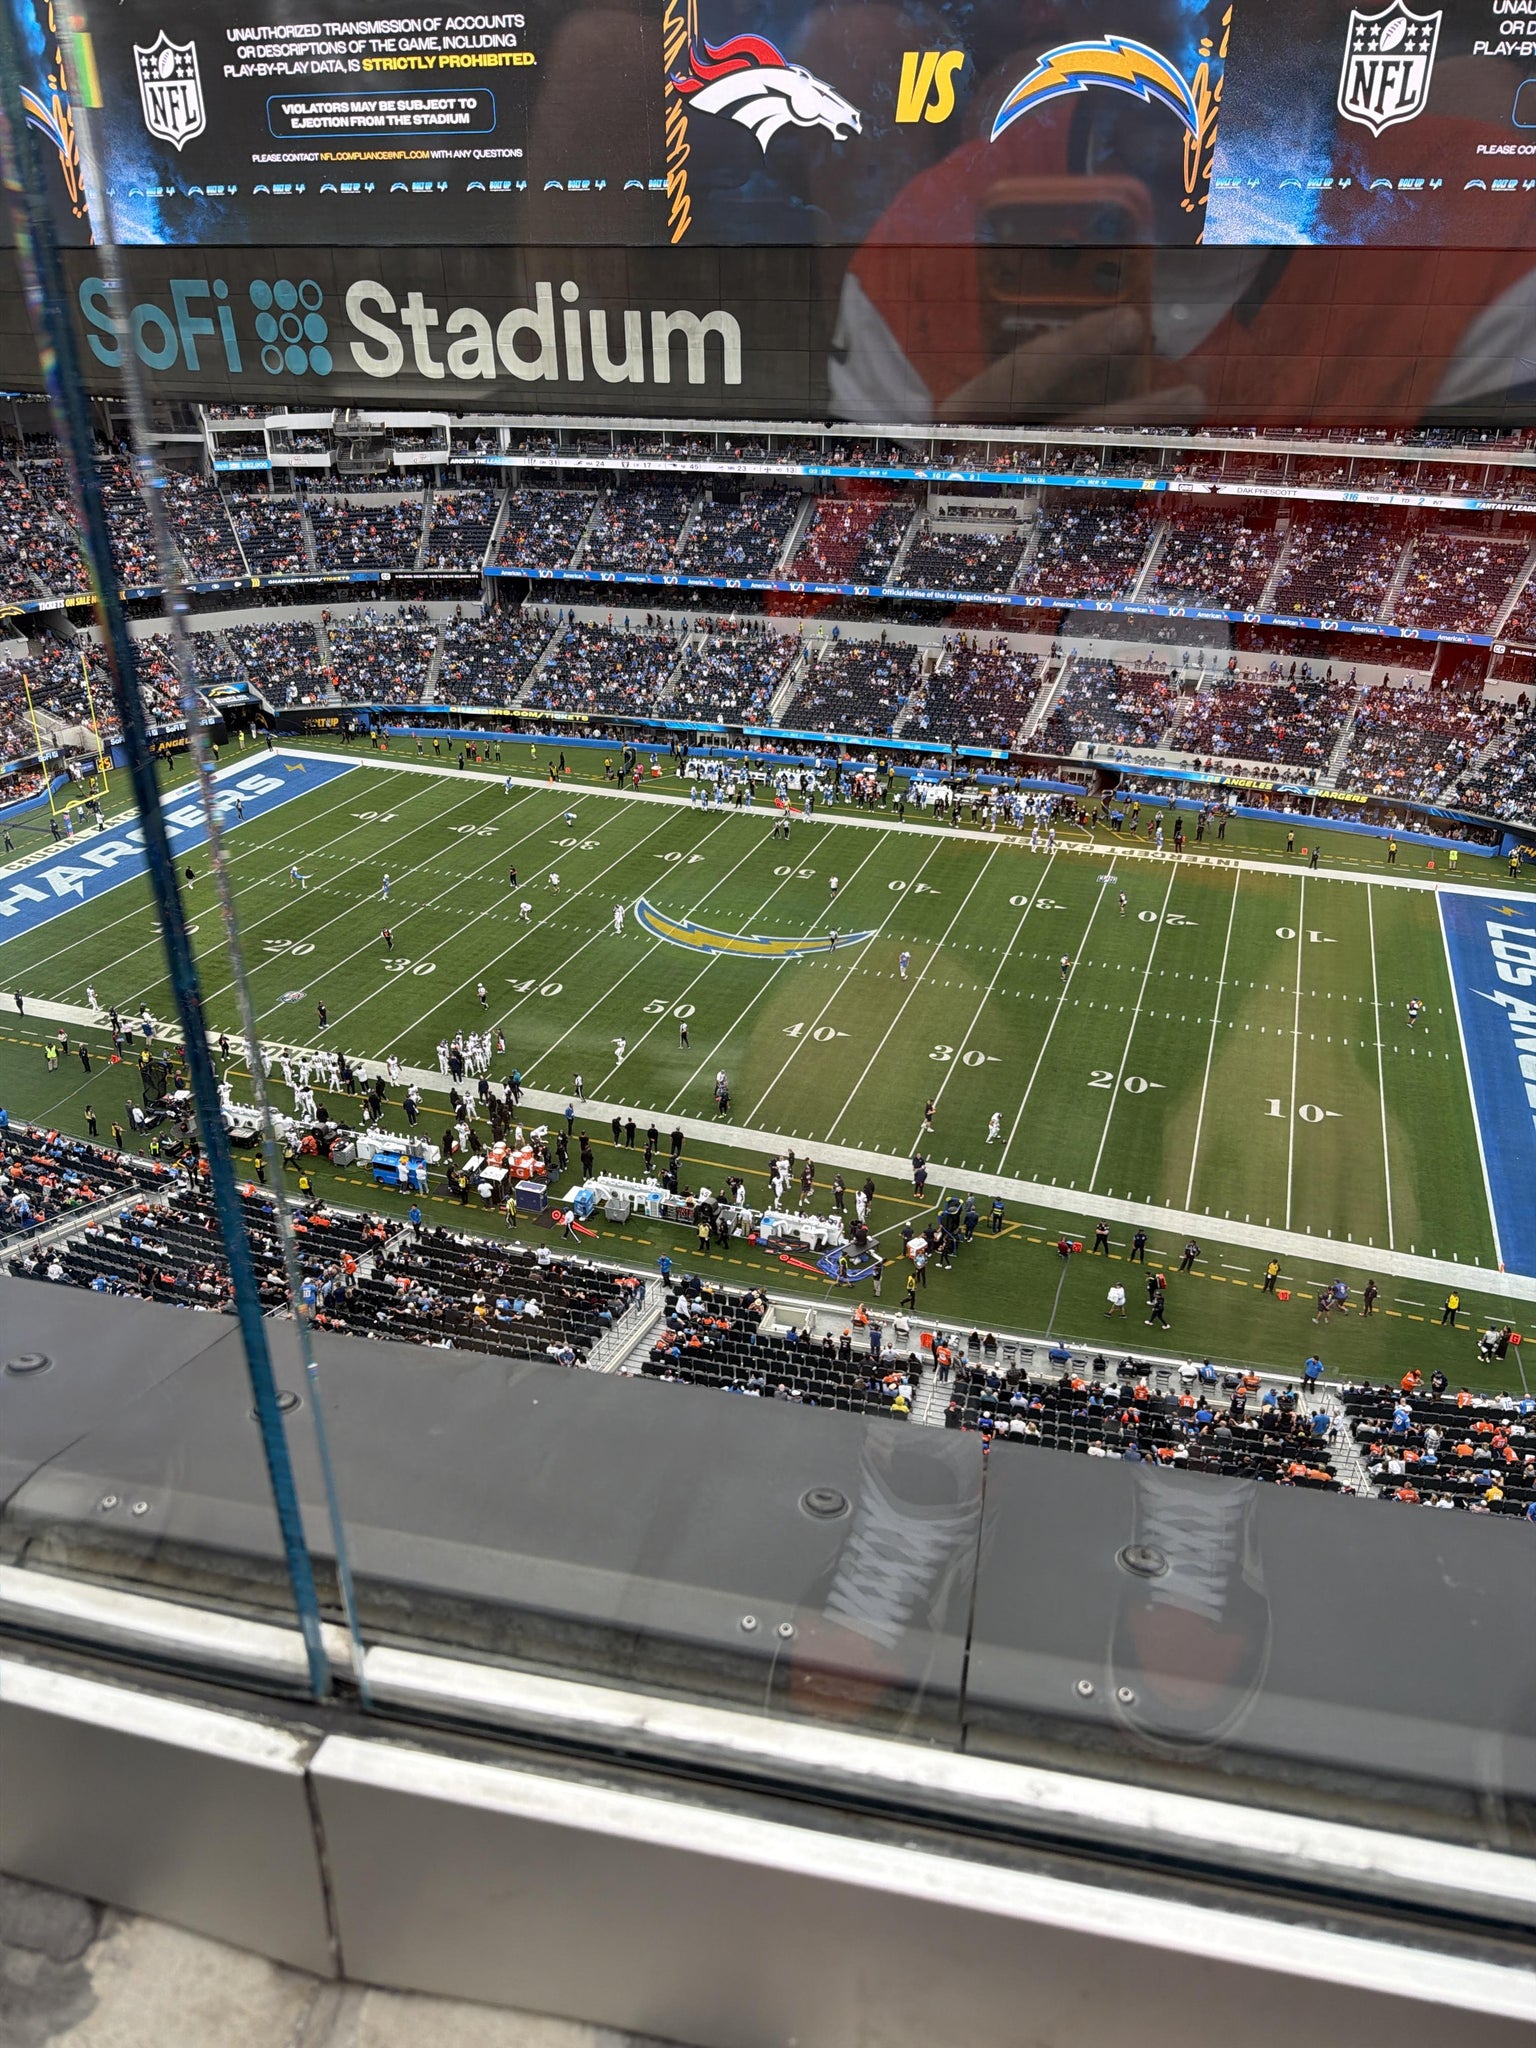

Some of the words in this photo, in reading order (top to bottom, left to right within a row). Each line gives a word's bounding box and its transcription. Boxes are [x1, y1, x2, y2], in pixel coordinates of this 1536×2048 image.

[227, 24, 321, 42] UNAUTHORIZED
[323, 19, 421, 36] TRANSMISSION
[423, 18, 442, 32] OF
[445, 14, 525, 30] ACCOUNTS
[1500, 21, 1522, 35] OR
[237, 46, 256, 59] OR
[258, 41, 347, 58] DESCRIPTIONS
[348, 40, 366, 53] OF
[368, 38, 397, 52] THE
[398, 37, 442, 51] GAME,
[442, 34, 517, 49] INCLUDING
[224, 61, 309, 78] PLAY-BY-PLAY
[310, 60, 347, 74] DATA,
[348, 59, 360, 71] IS
[362, 56, 436, 71] STRICTLY
[438, 52, 537, 68] PROHIBITED.
[894, 51, 964, 123] VS
[1349, 60, 1416, 115] NFL
[148, 82, 200, 135] NFL
[282, 102, 349, 115] VIOLATORS
[351, 101, 377, 112] MAY
[379, 100, 396, 111] BE
[397, 99, 456, 111] SUBJECT
[458, 98, 477, 109] TO
[291, 117, 349, 129] EJECTION
[350, 116, 384, 127] FROM
[386, 115, 412, 126] THE
[414, 113, 470, 125] STADIUM
[252, 154, 282, 163] PLEASE
[282, 152, 319, 162] CONTACT
[431, 150, 452, 158] WITH
[453, 149, 472, 158] ANY
[473, 148, 523, 158] QUESTIONS
[1476, 144, 1516, 154] PLEASE
[79, 278, 242, 373] SoFi
[346, 280, 742, 384] Stadium
[1254, 488, 1298, 496] PRESCOTT
[1343, 493, 1358, 501] 316
[1476, 502, 1511, 510] FANTASY
[268, 575, 349, 584] CHARGERS.COM/TICKETS
[38, 599, 64, 611] TICKETS
[66, 599, 74, 608] ON
[75, 596, 90, 606] SALE
[905, 590, 925, 598] Airline
[958, 593, 982, 602] Angeles
[984, 595, 1011, 603] Chargers
[1273, 618, 1298, 626] American
[1351, 625, 1377, 633] American
[1438, 634, 1465, 642] American
[450, 706, 589, 721] CHARGERS.COM/TICKETS
[166, 724, 180, 733] SoFi
[38, 753, 51, 762] SoFi
[1200, 774, 1221, 783] LOS
[1224, 776, 1273, 790] ANGELES
[1306, 788, 1368, 803] CHARGERS
[367, 811, 398, 823] 10
[458, 824, 500, 836] 20
[4, 829, 90, 872] CRUCIAL
[558, 837, 600, 850] 30
[664, 852, 705, 864] 40
[773, 866, 816, 880] 50
[888, 880, 932, 894] 40
[1009, 894, 1055, 910] 30
[1138, 911, 1186, 926] 20
[1275, 927, 1325, 943] 10
[268, 940, 316, 956] 20
[385, 958, 437, 976] 30
[514, 978, 564, 997] 40
[643, 999, 696, 1019] 50
[782, 1022, 836, 1043] 40
[929, 1044, 986, 1068] 30
[1087, 1071, 1149, 1094] 20
[1264, 1098, 1324, 1123] 10
